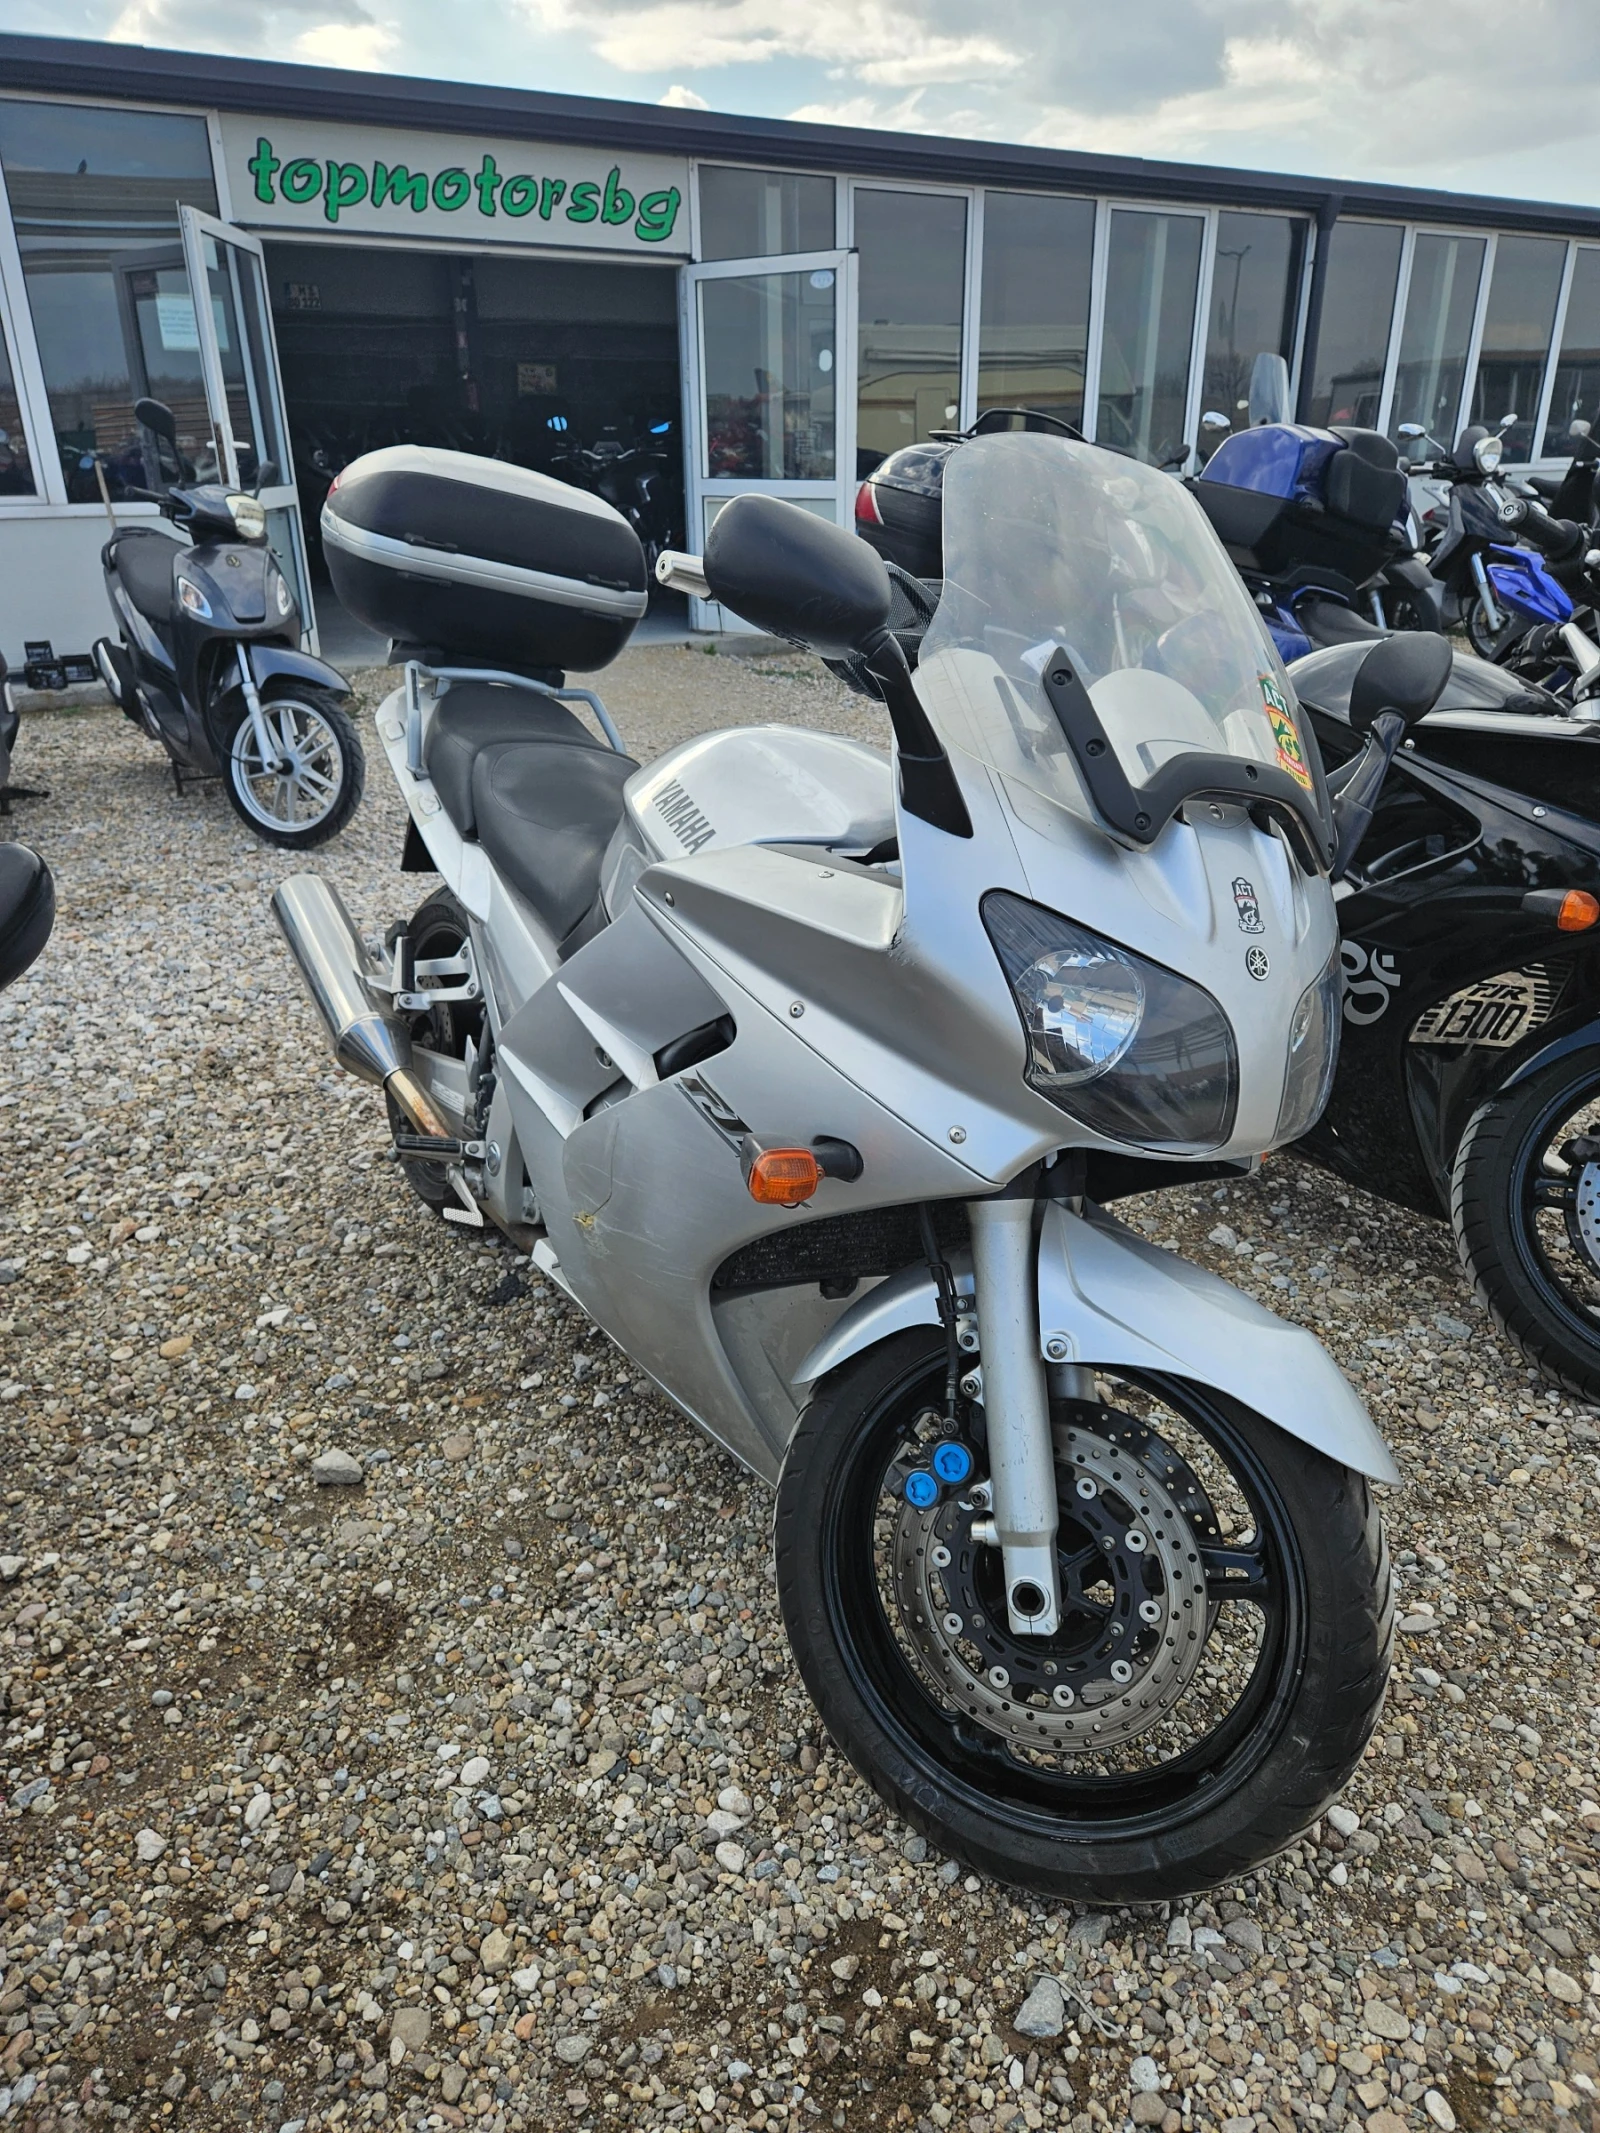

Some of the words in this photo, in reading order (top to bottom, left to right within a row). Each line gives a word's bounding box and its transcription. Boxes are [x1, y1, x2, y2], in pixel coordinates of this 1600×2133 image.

[248, 137, 681, 242] topmotorsbg
[1264, 683, 1290, 718] ACT
[652, 779, 717, 856] YAMAHA
[1235, 884, 1252, 897] ACT
[1467, 982, 1529, 1001] FJR
[1435, 998, 1529, 1041] 1300
[678, 1068, 754, 1147] FJ
